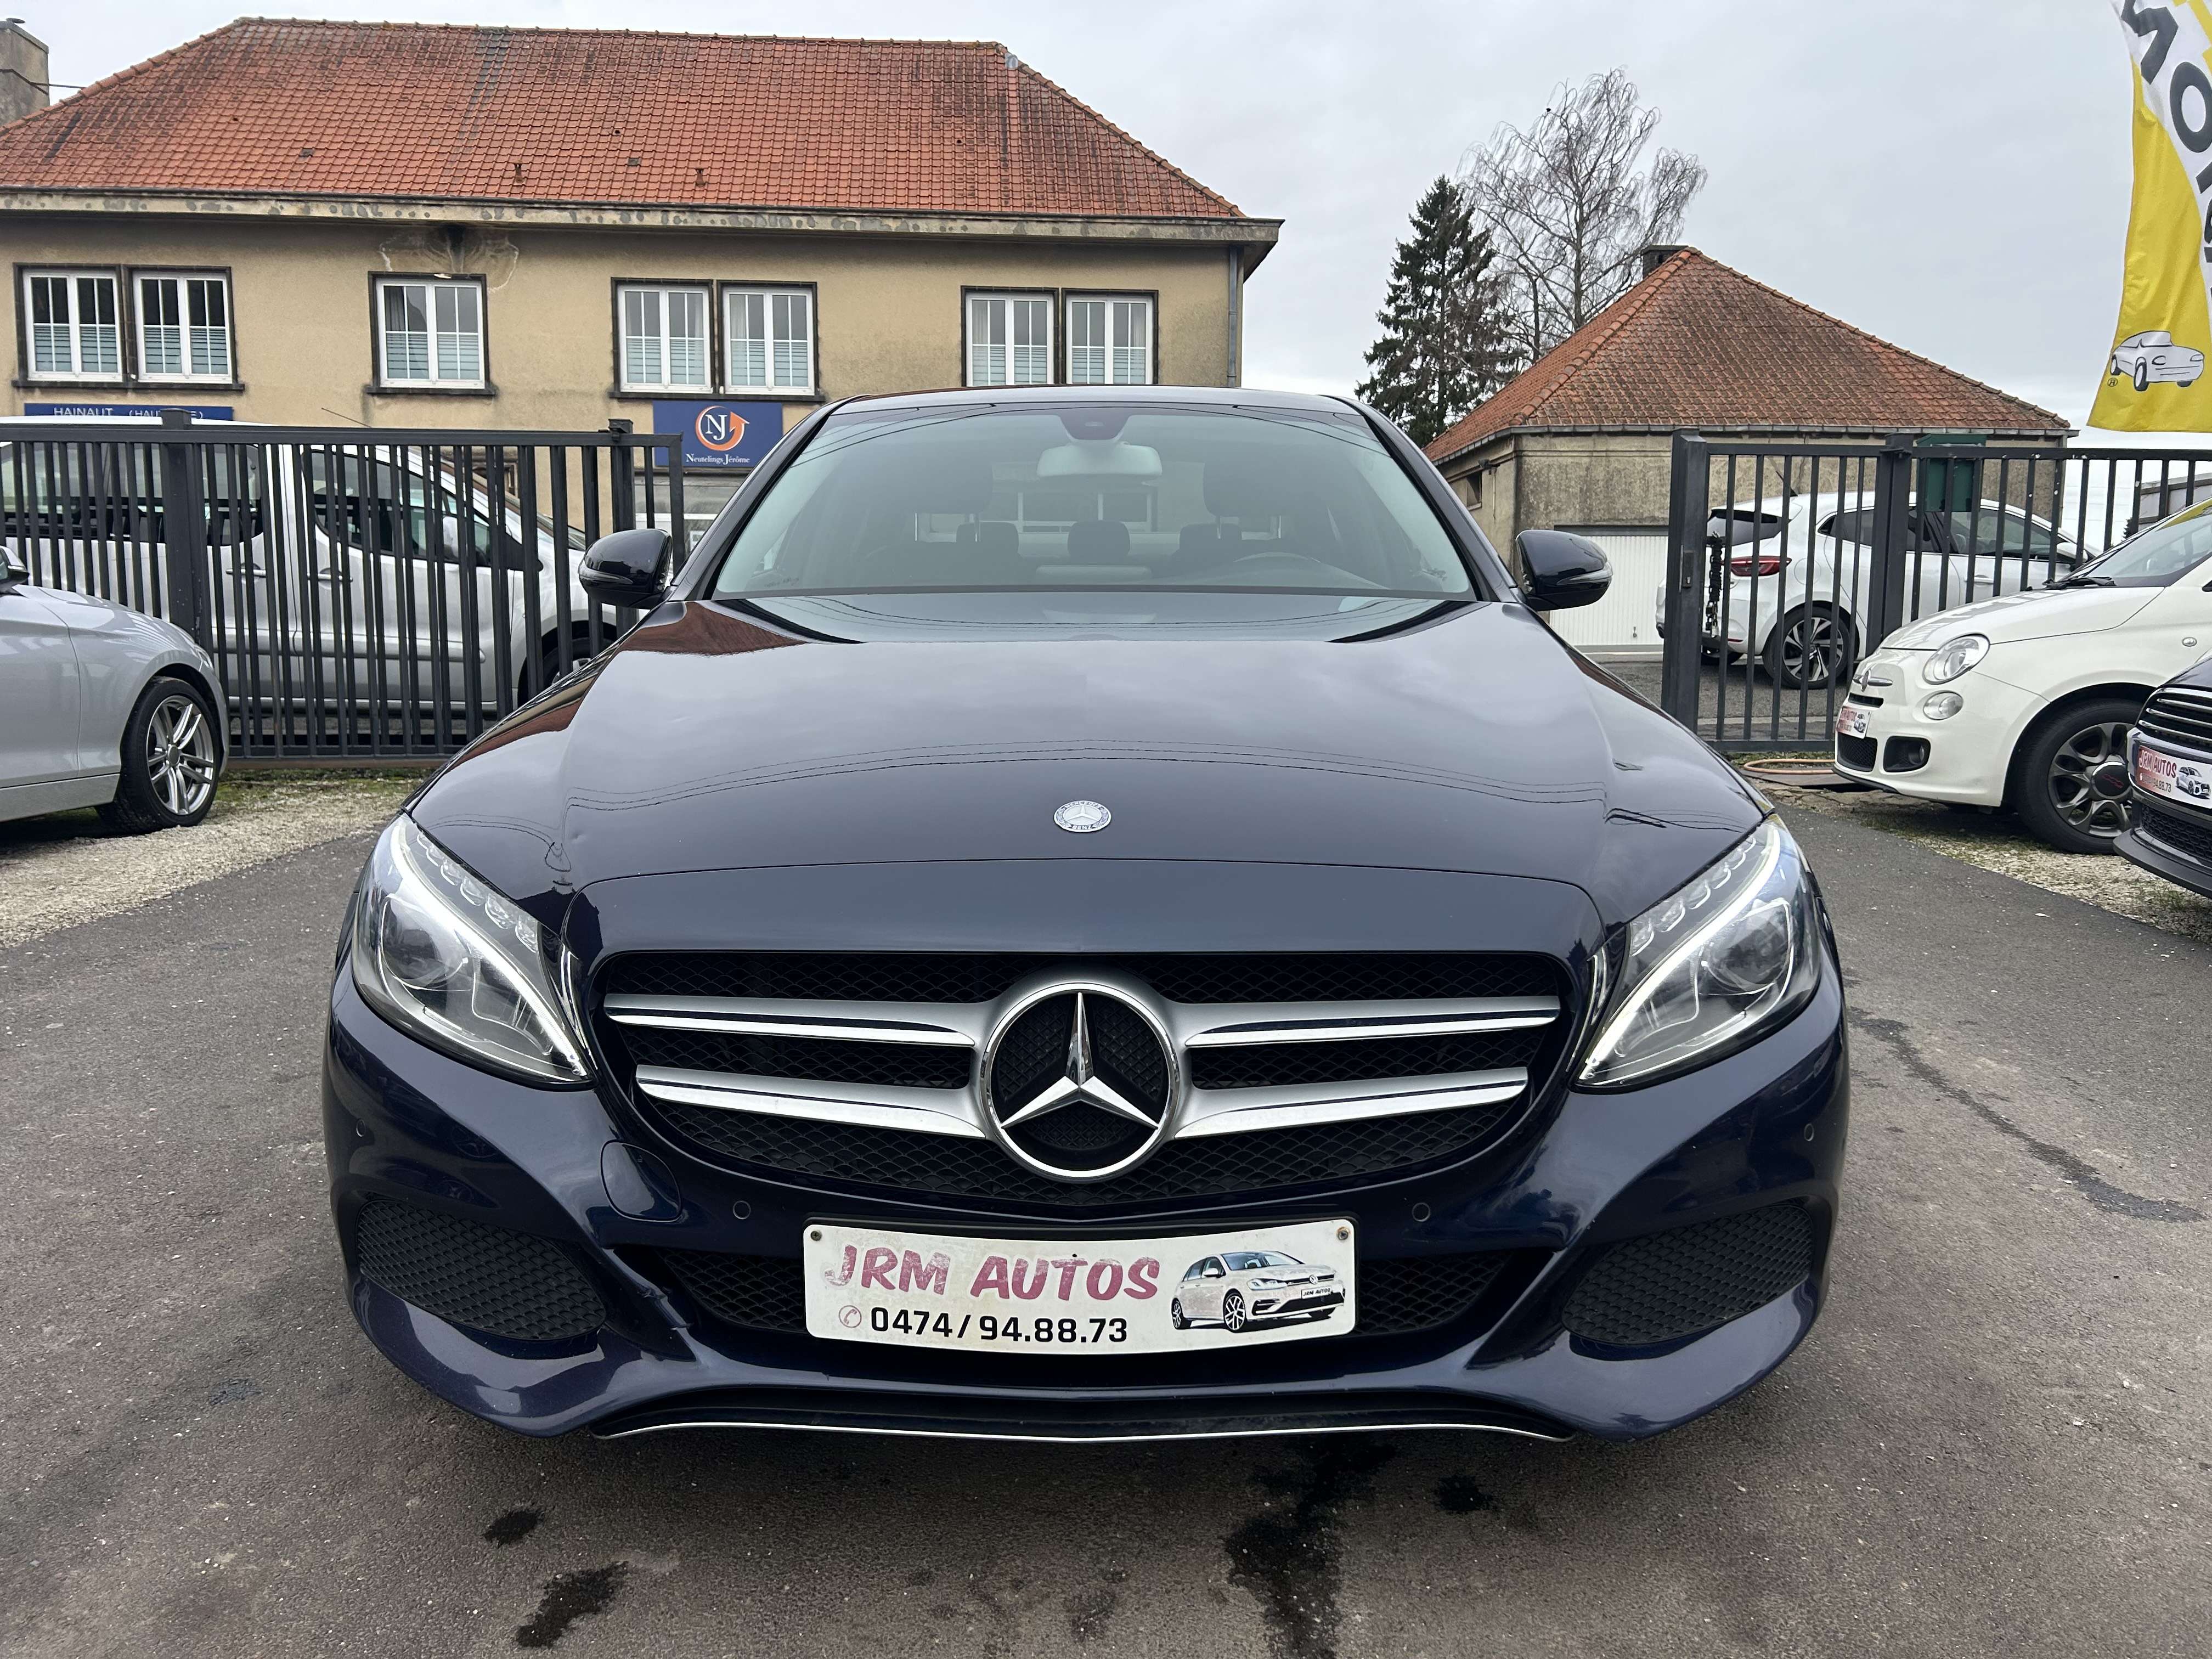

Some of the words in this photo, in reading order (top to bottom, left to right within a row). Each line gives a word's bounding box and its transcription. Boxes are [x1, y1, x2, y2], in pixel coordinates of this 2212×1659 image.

[54, 407, 113, 416] HAINAUT
[705, 414, 727, 441] NJ
[2154, 756, 2177, 778] AUTOS
[825, 1244, 951, 1295] JRM
[970, 1255, 1160, 1301] AUTOS
